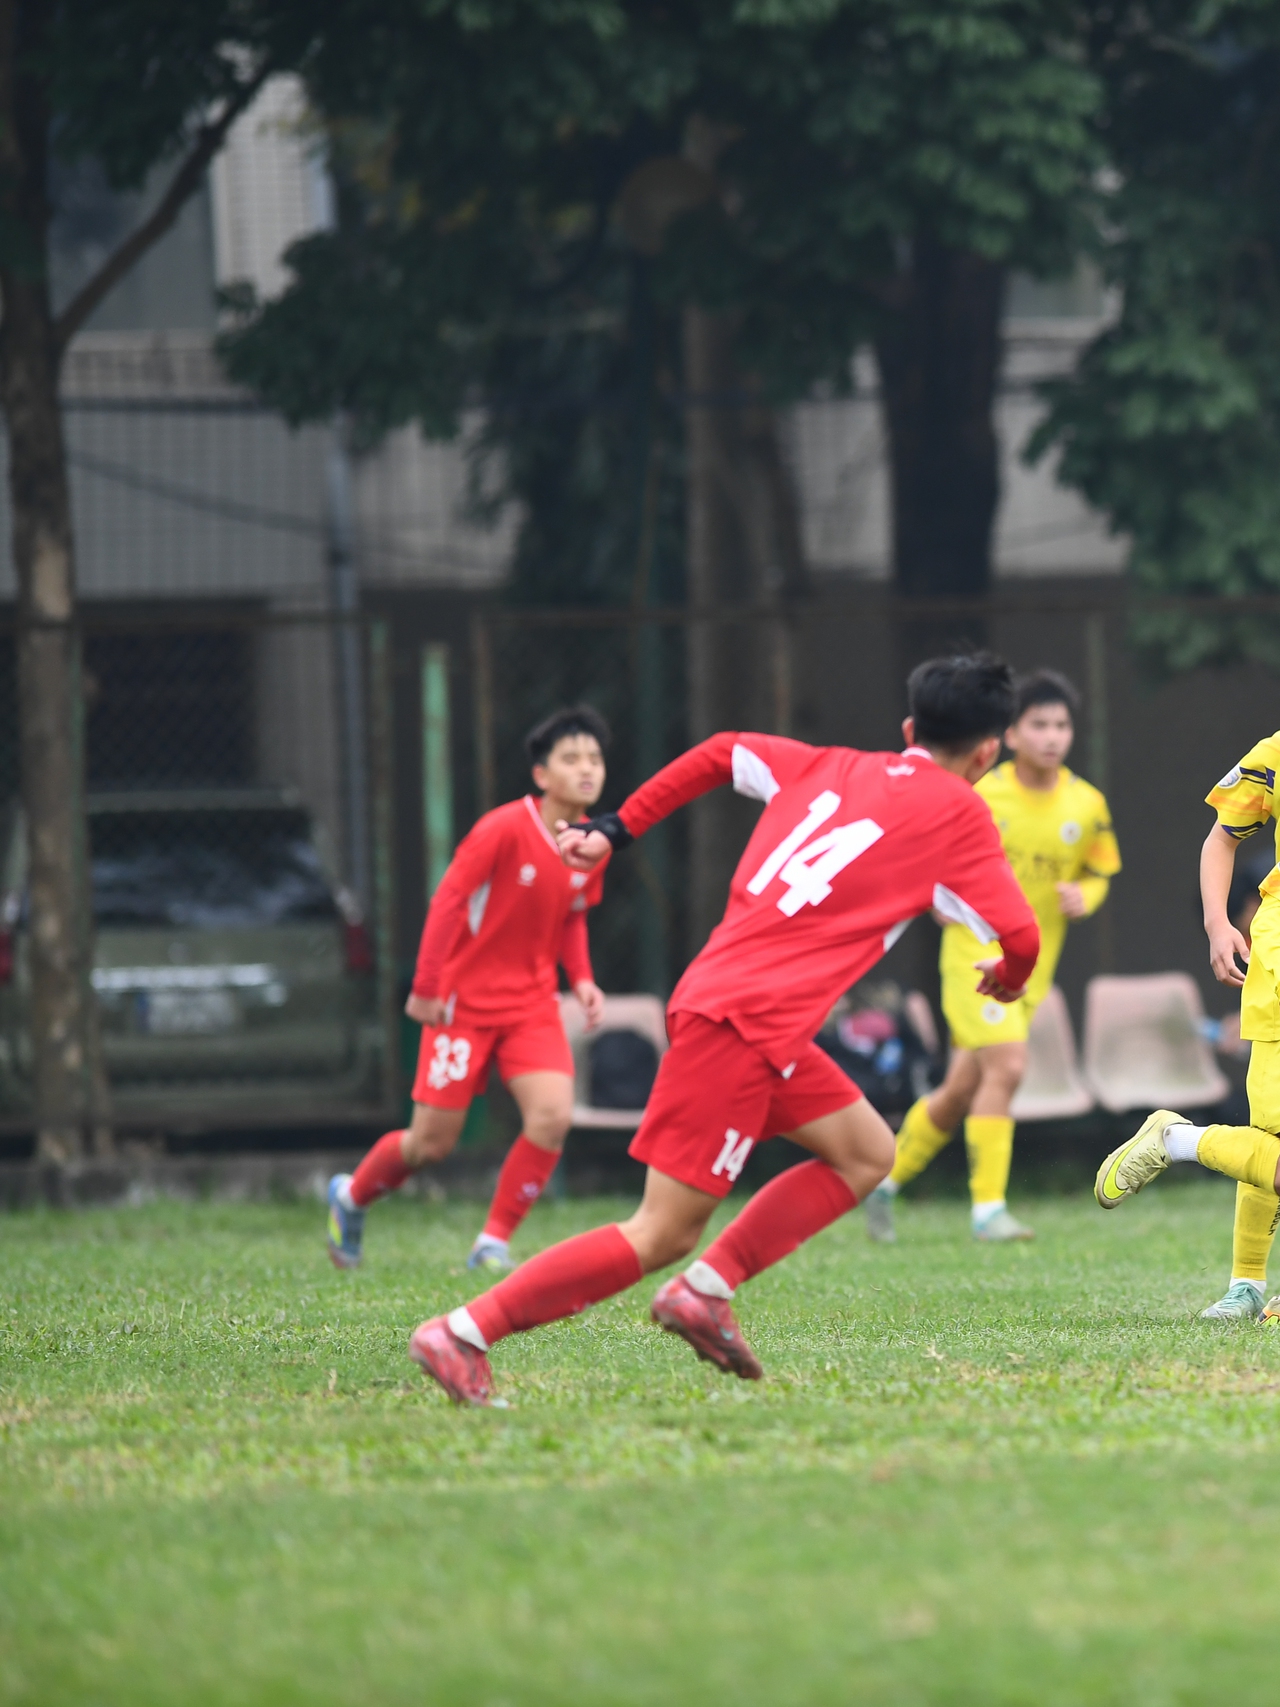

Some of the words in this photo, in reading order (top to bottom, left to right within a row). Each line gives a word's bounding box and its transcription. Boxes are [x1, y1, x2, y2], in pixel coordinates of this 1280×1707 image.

[746, 789, 884, 917] 14
[429, 1033, 472, 1081] 33
[711, 1127, 754, 1182] 14
